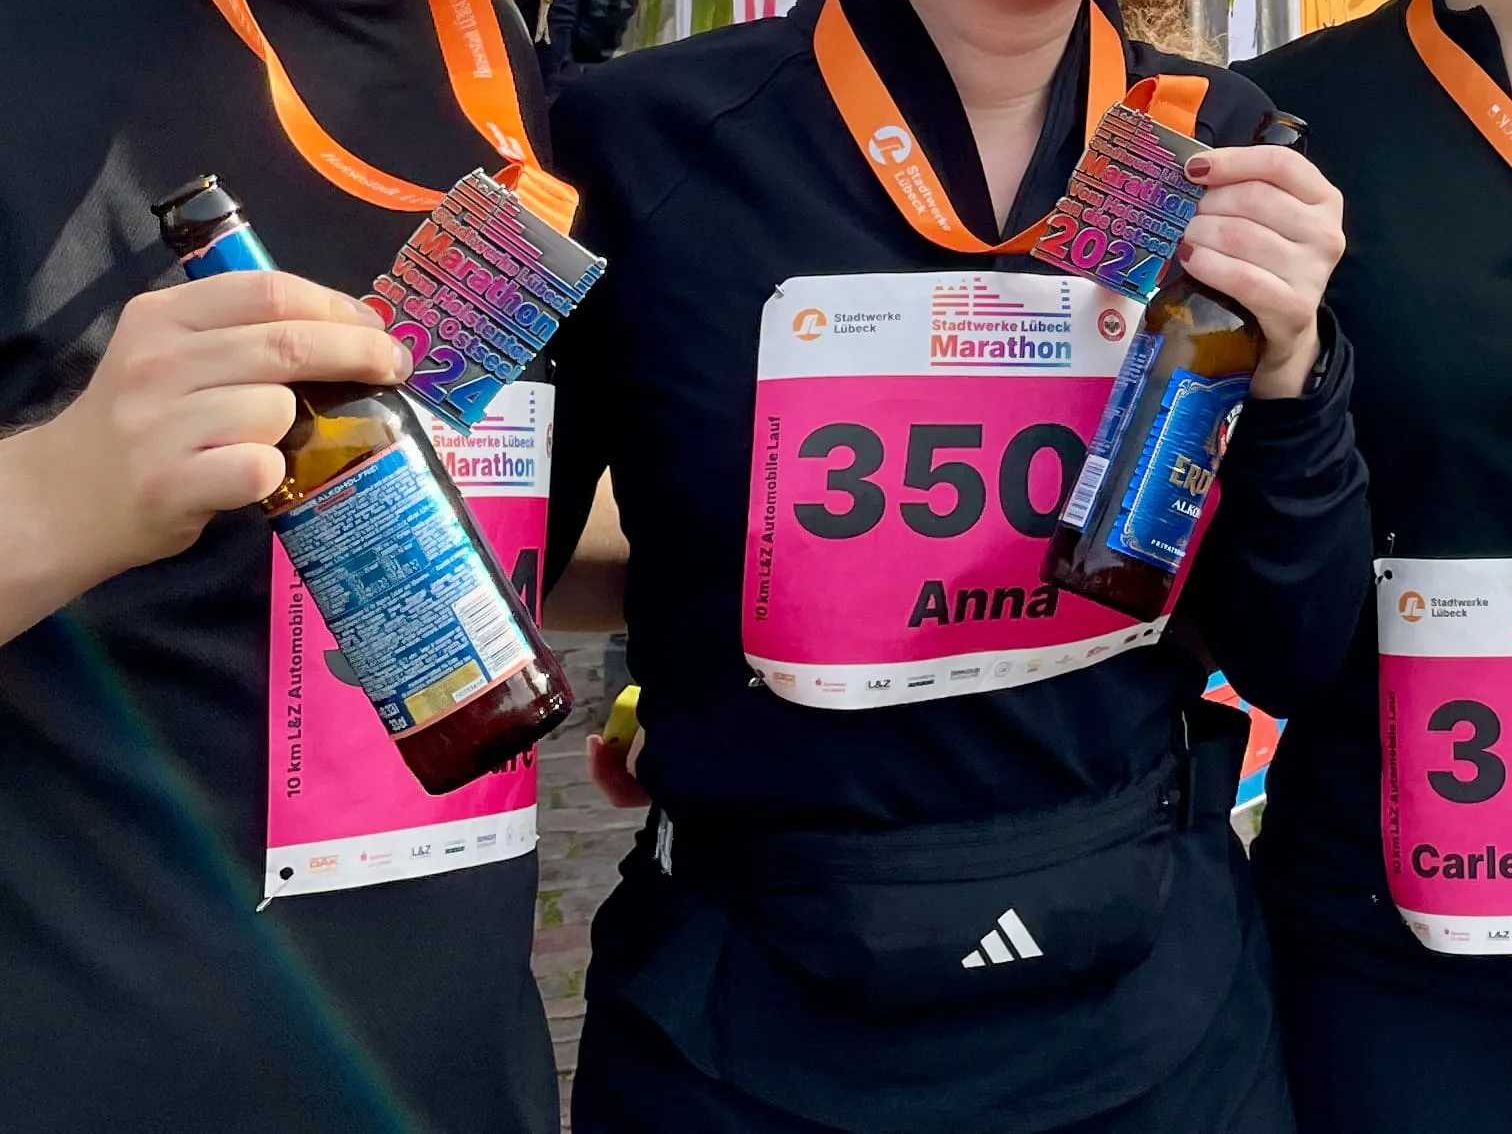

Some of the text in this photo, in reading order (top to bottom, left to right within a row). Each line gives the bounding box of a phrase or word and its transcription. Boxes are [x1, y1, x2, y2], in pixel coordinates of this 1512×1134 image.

[893, 172, 927, 216] Lübeck
[907, 164, 952, 233] Stadtwerke
[1080, 149, 1197, 222] Marathon
[1039, 213, 1169, 300] 2024
[406, 218, 559, 346] Marathon
[434, 286, 537, 364] Holstentor
[834, 312, 901, 323] Stadtwerke
[834, 323, 877, 334] Lübeck
[931, 318, 1072, 334] Stadtwerke Lübeck
[931, 335, 1072, 359] Marathon
[432, 435, 535, 449] Stadtwerke Lübeck
[793, 423, 1089, 540] 350
[1169, 454, 1213, 497] ERD
[756, 416, 781, 623] 10 km L&Z Automobile Lauf
[1172, 498, 1201, 519] ALKO
[907, 580, 1059, 628] Anna
[1431, 597, 1489, 608] Stadtwerke
[1431, 607, 1467, 618] Lübeck
[288, 593, 303, 699] Automobile
[868, 679, 891, 689] L&Z
[288, 704, 302, 740] L&Z
[288, 744, 302, 772] km
[288, 778, 302, 798] 10
[411, 844, 431, 857] L&Z
[1488, 930, 1510, 939] L&Z
